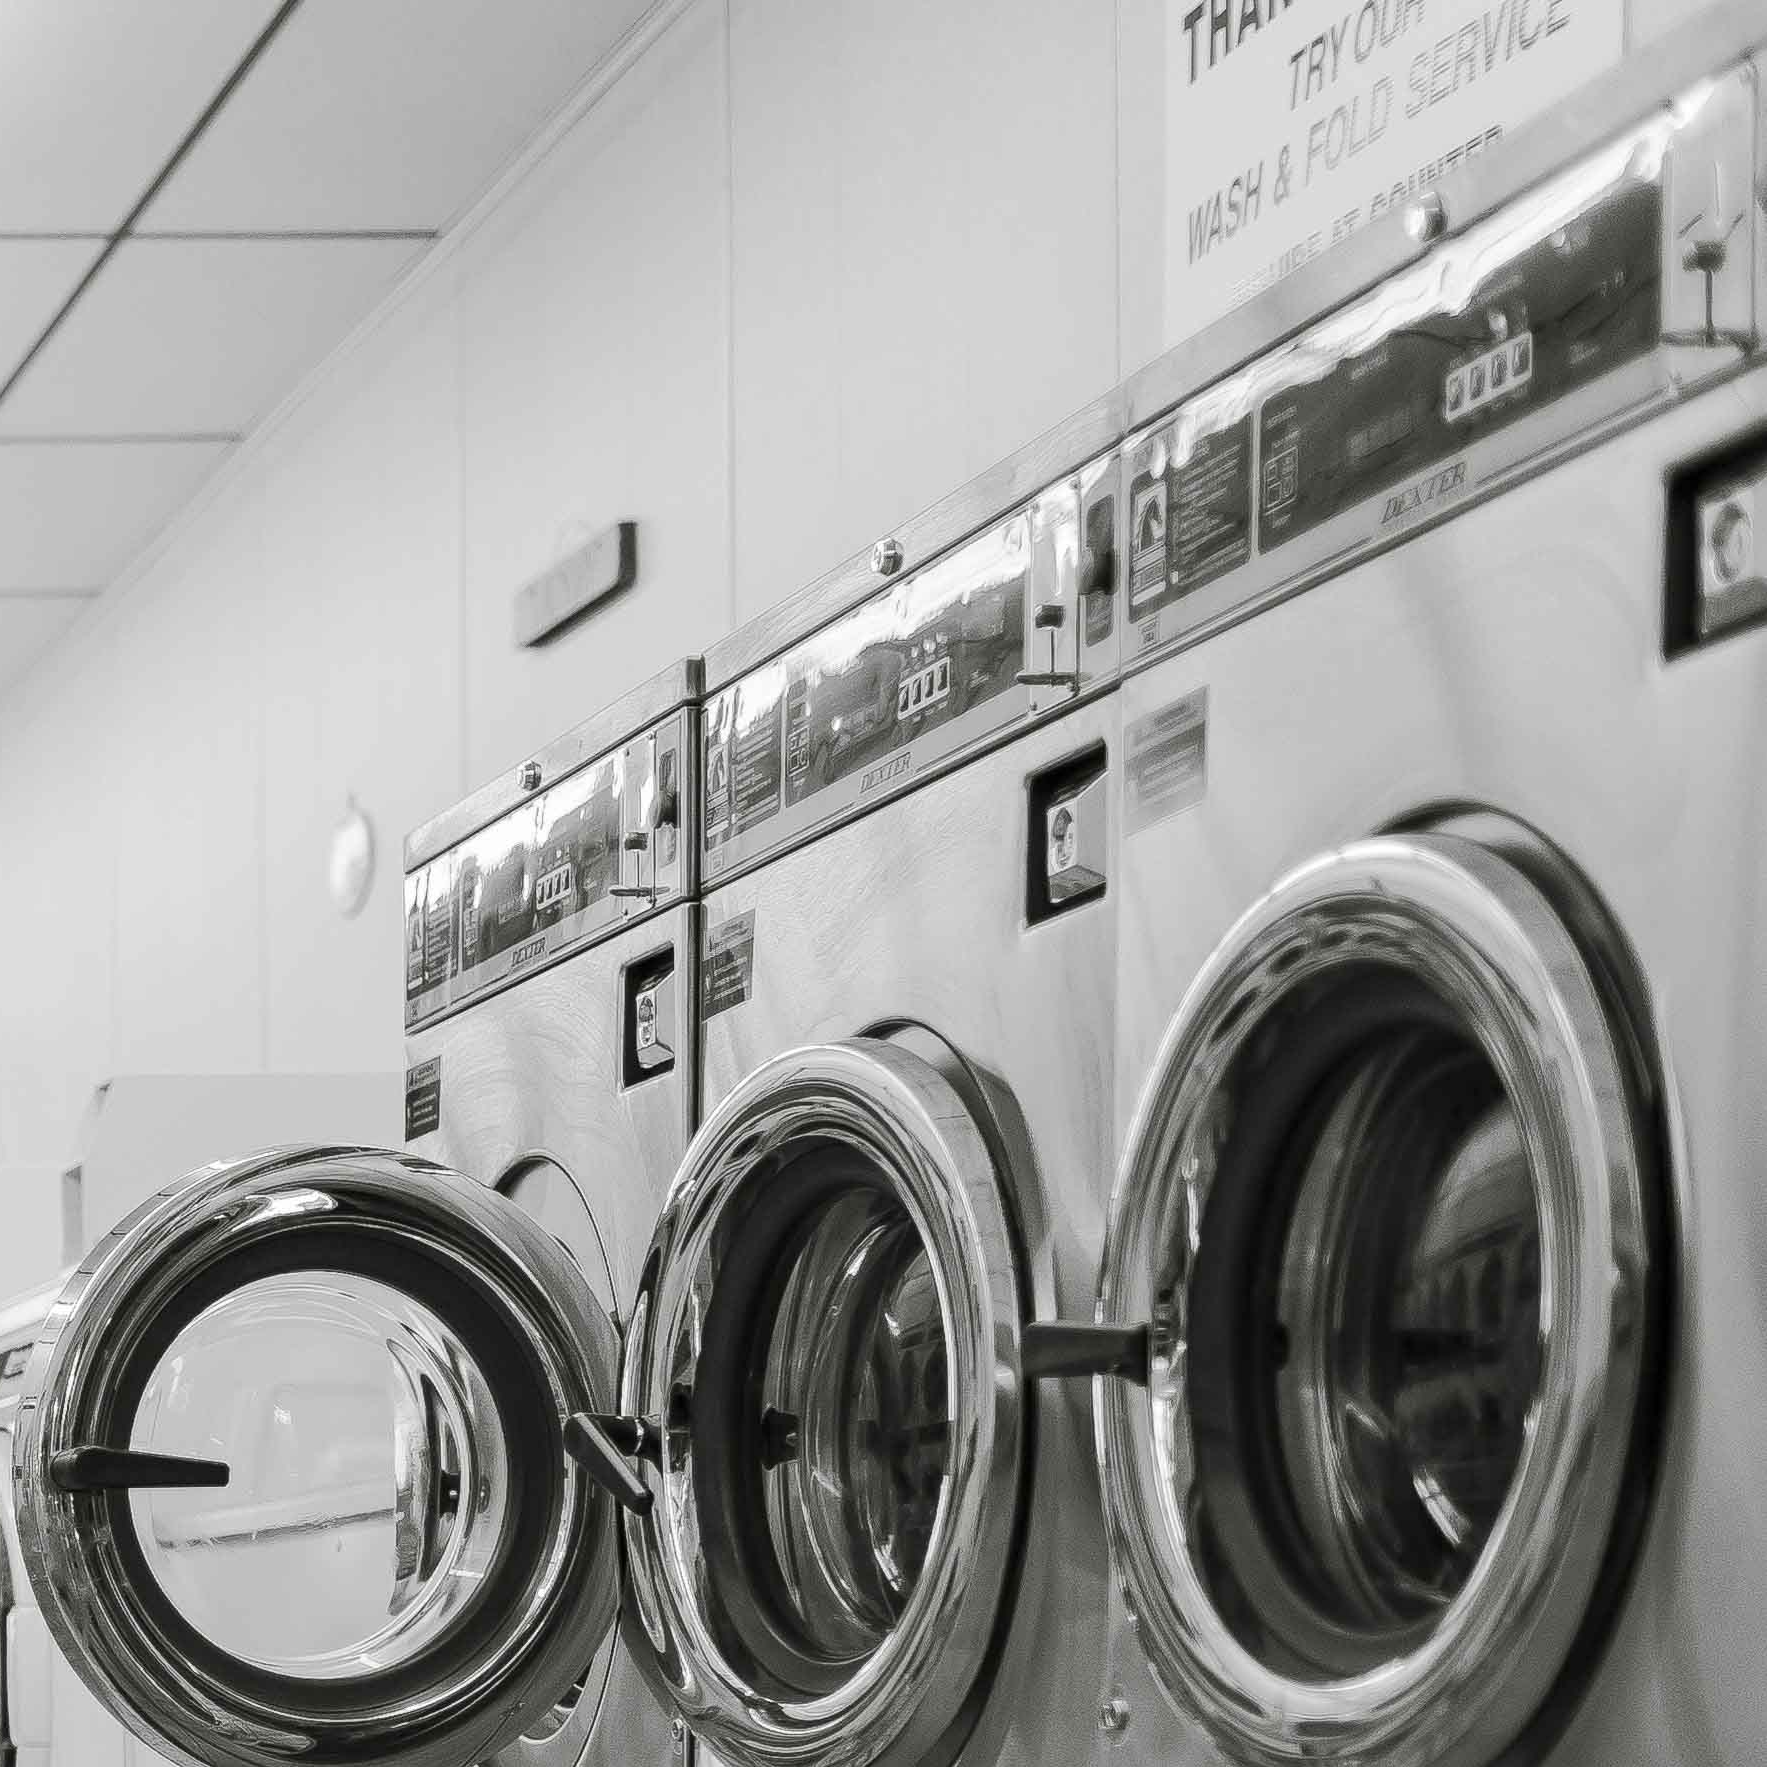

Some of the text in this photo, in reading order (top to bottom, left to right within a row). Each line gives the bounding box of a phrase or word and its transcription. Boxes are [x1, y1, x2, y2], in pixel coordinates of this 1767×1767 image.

[1183, 0, 1291, 85] THA
[1289, 13, 1352, 111] TRY
[1187, 160, 1263, 264] WASH
[1273, 143, 1293, 205] &
[1305, 76, 1393, 186] FOLD
[1380, 462, 1466, 524] DEXTER
